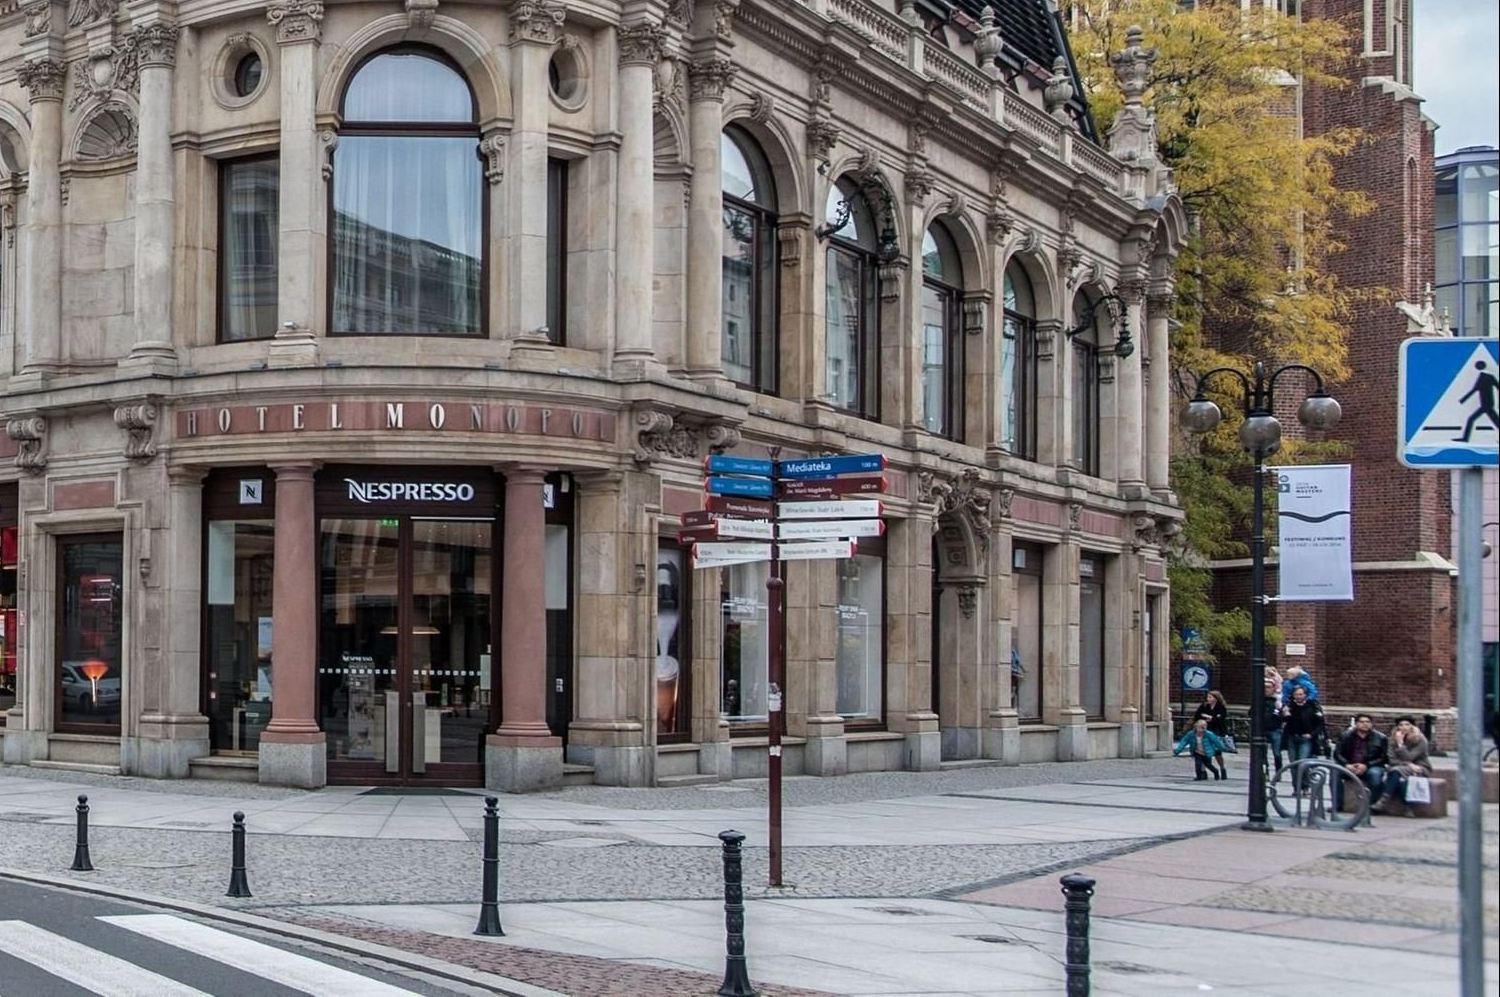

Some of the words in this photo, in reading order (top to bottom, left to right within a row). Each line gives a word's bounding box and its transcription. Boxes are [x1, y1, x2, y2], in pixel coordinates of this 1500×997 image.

[187, 403, 343, 435] HOTEL
[387, 402, 609, 440] MONOPOL
[786, 462, 831, 473] Mediateka
[343, 477, 473, 503] NESPRESSO
